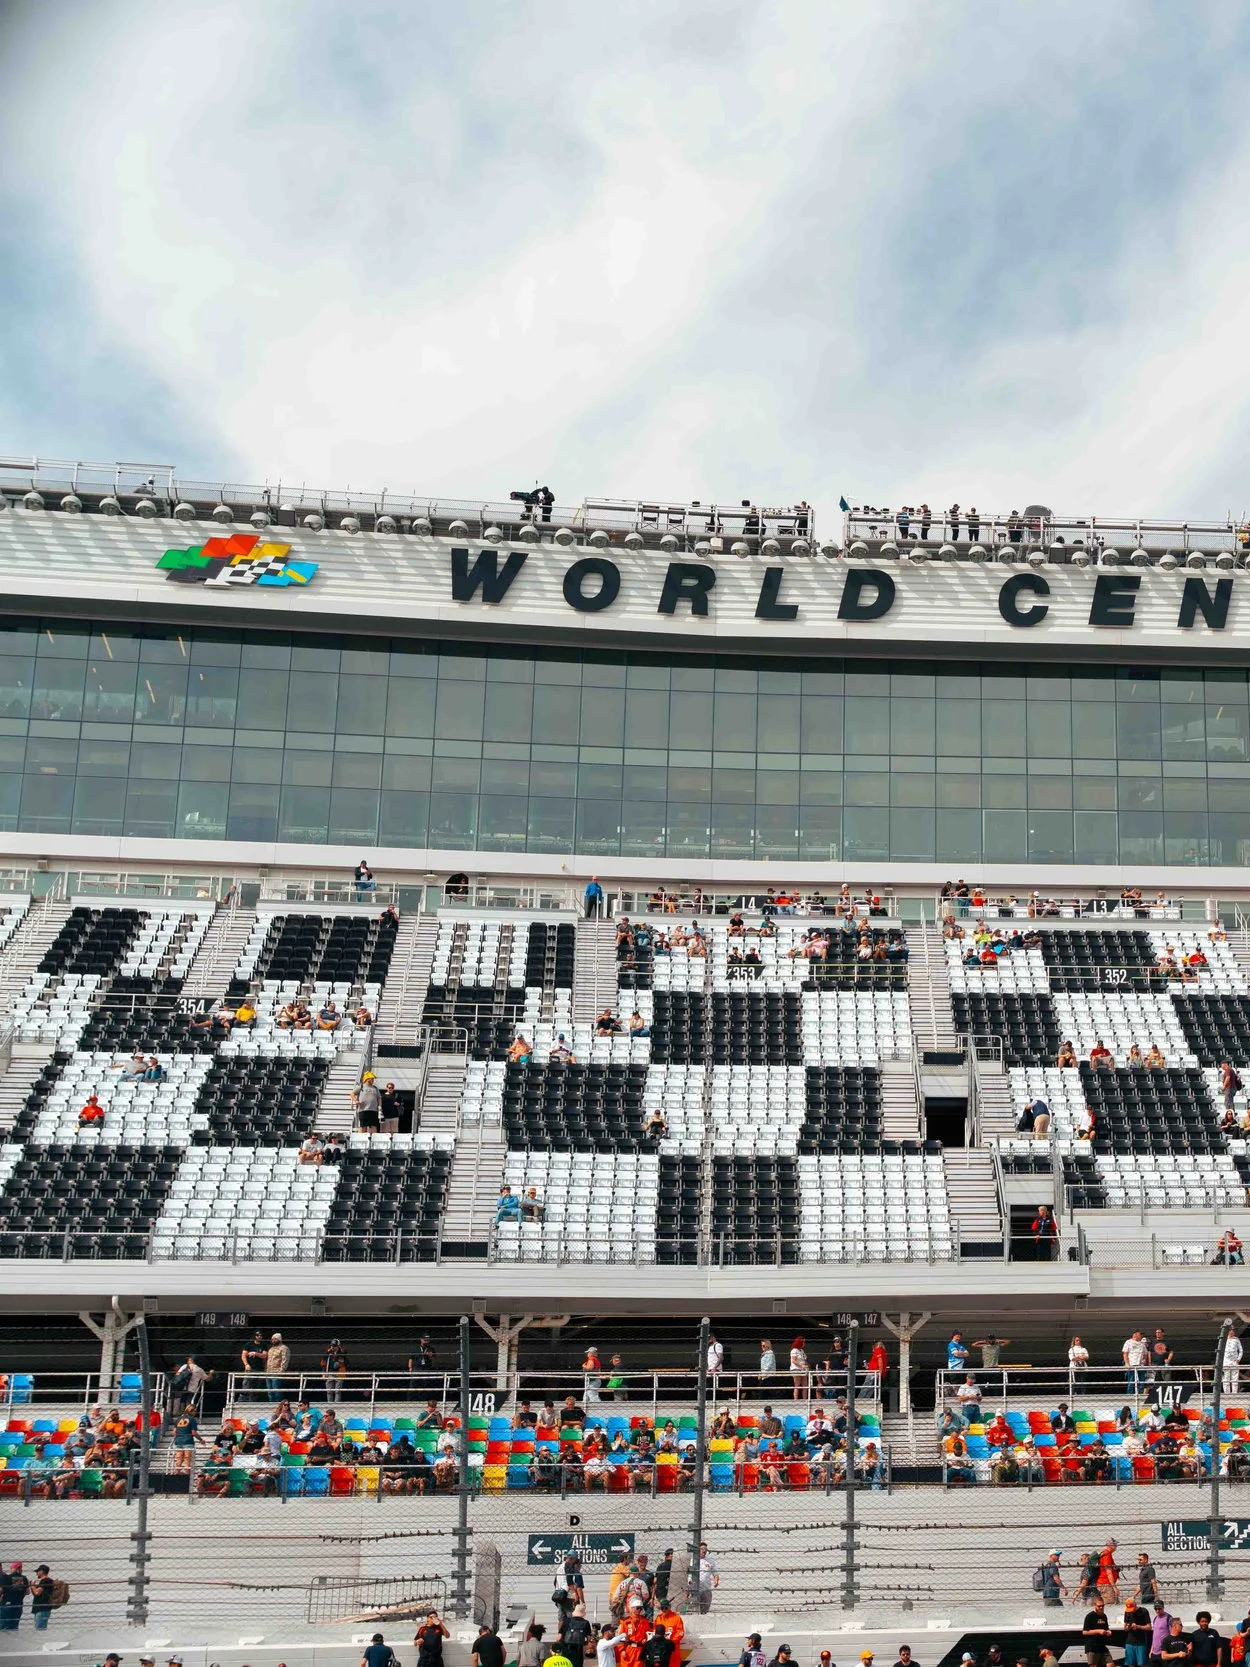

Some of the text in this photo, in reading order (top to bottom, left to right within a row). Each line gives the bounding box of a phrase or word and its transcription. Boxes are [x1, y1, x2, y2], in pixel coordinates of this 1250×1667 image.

[451, 548, 895, 620] WORLD
[742, 897, 756, 911] L4
[1093, 900, 1107, 915] L3
[733, 967, 755, 981] 353
[1105, 969, 1127, 984] 352
[179, 999, 205, 1014] 354
[200, 1313, 246, 1325] 149 148
[837, 1313, 878, 1325] 148 147
[1156, 1385, 1184, 1408] 147
[569, 1515, 580, 1526] D
[1167, 1522, 1186, 1537] ALL
[571, 1534, 592, 1549] ALL
